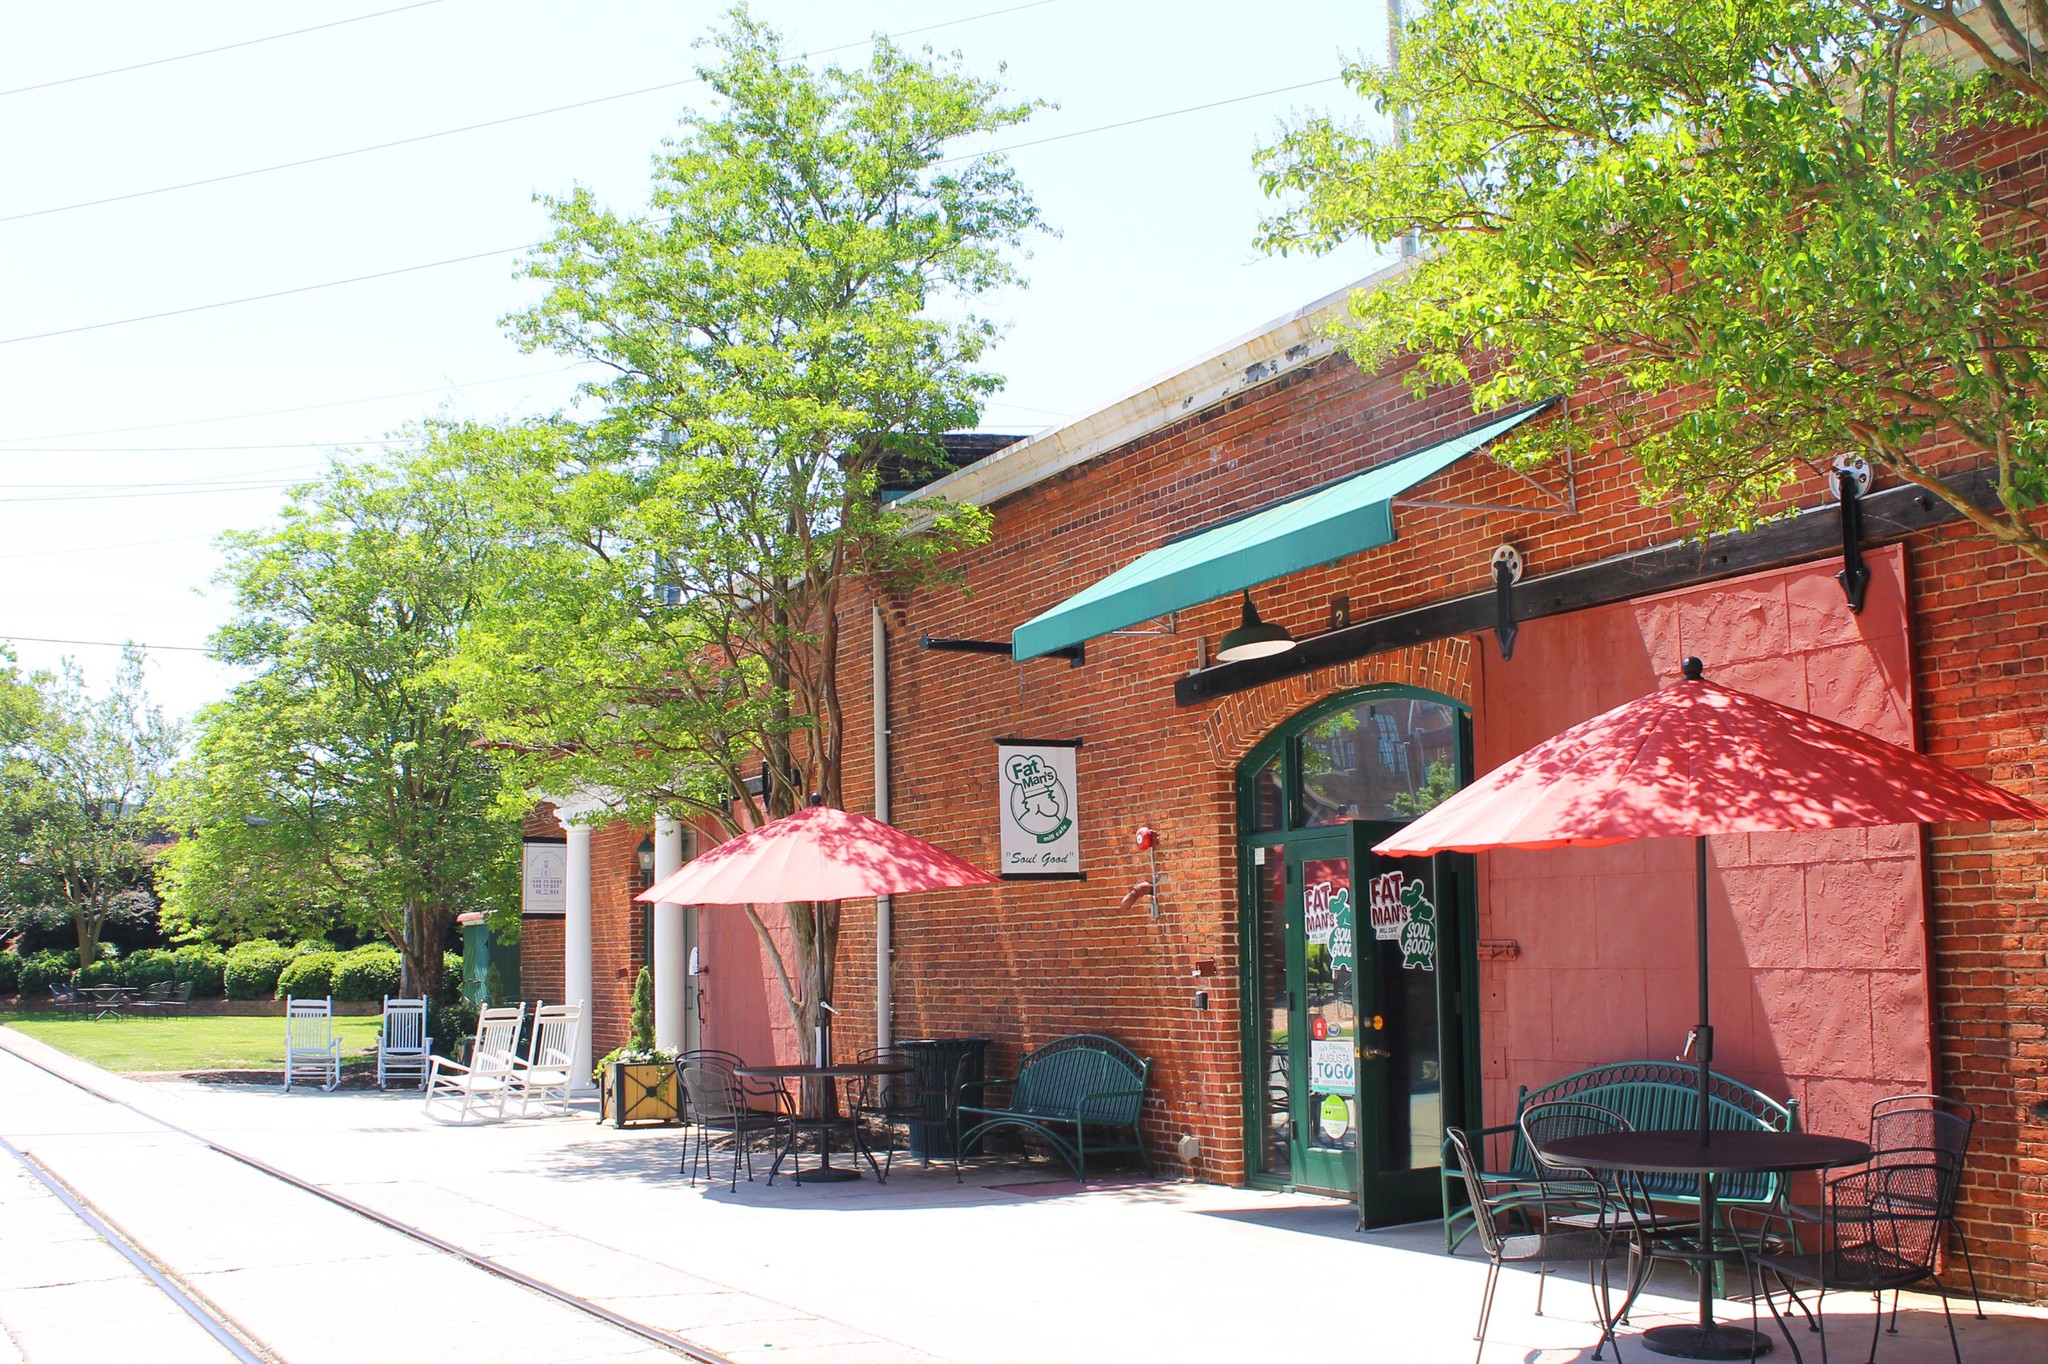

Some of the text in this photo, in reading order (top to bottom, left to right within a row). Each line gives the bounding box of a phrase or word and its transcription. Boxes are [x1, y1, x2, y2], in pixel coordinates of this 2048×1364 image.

[1335, 610, 1344, 628] 2
[1012, 760, 1040, 779] Fat
[1022, 771, 1054, 789] Man's
[1370, 873, 1402, 904] FAT
[1304, 885, 1330, 913] FAT
[1334, 927, 1352, 943] SOU
[1407, 921, 1431, 940] SOUL
[1404, 940, 1435, 957] GOOD!
[1319, 1054, 1350, 1063] AUGUSTA
[1317, 1063, 1353, 1080] TOGO
